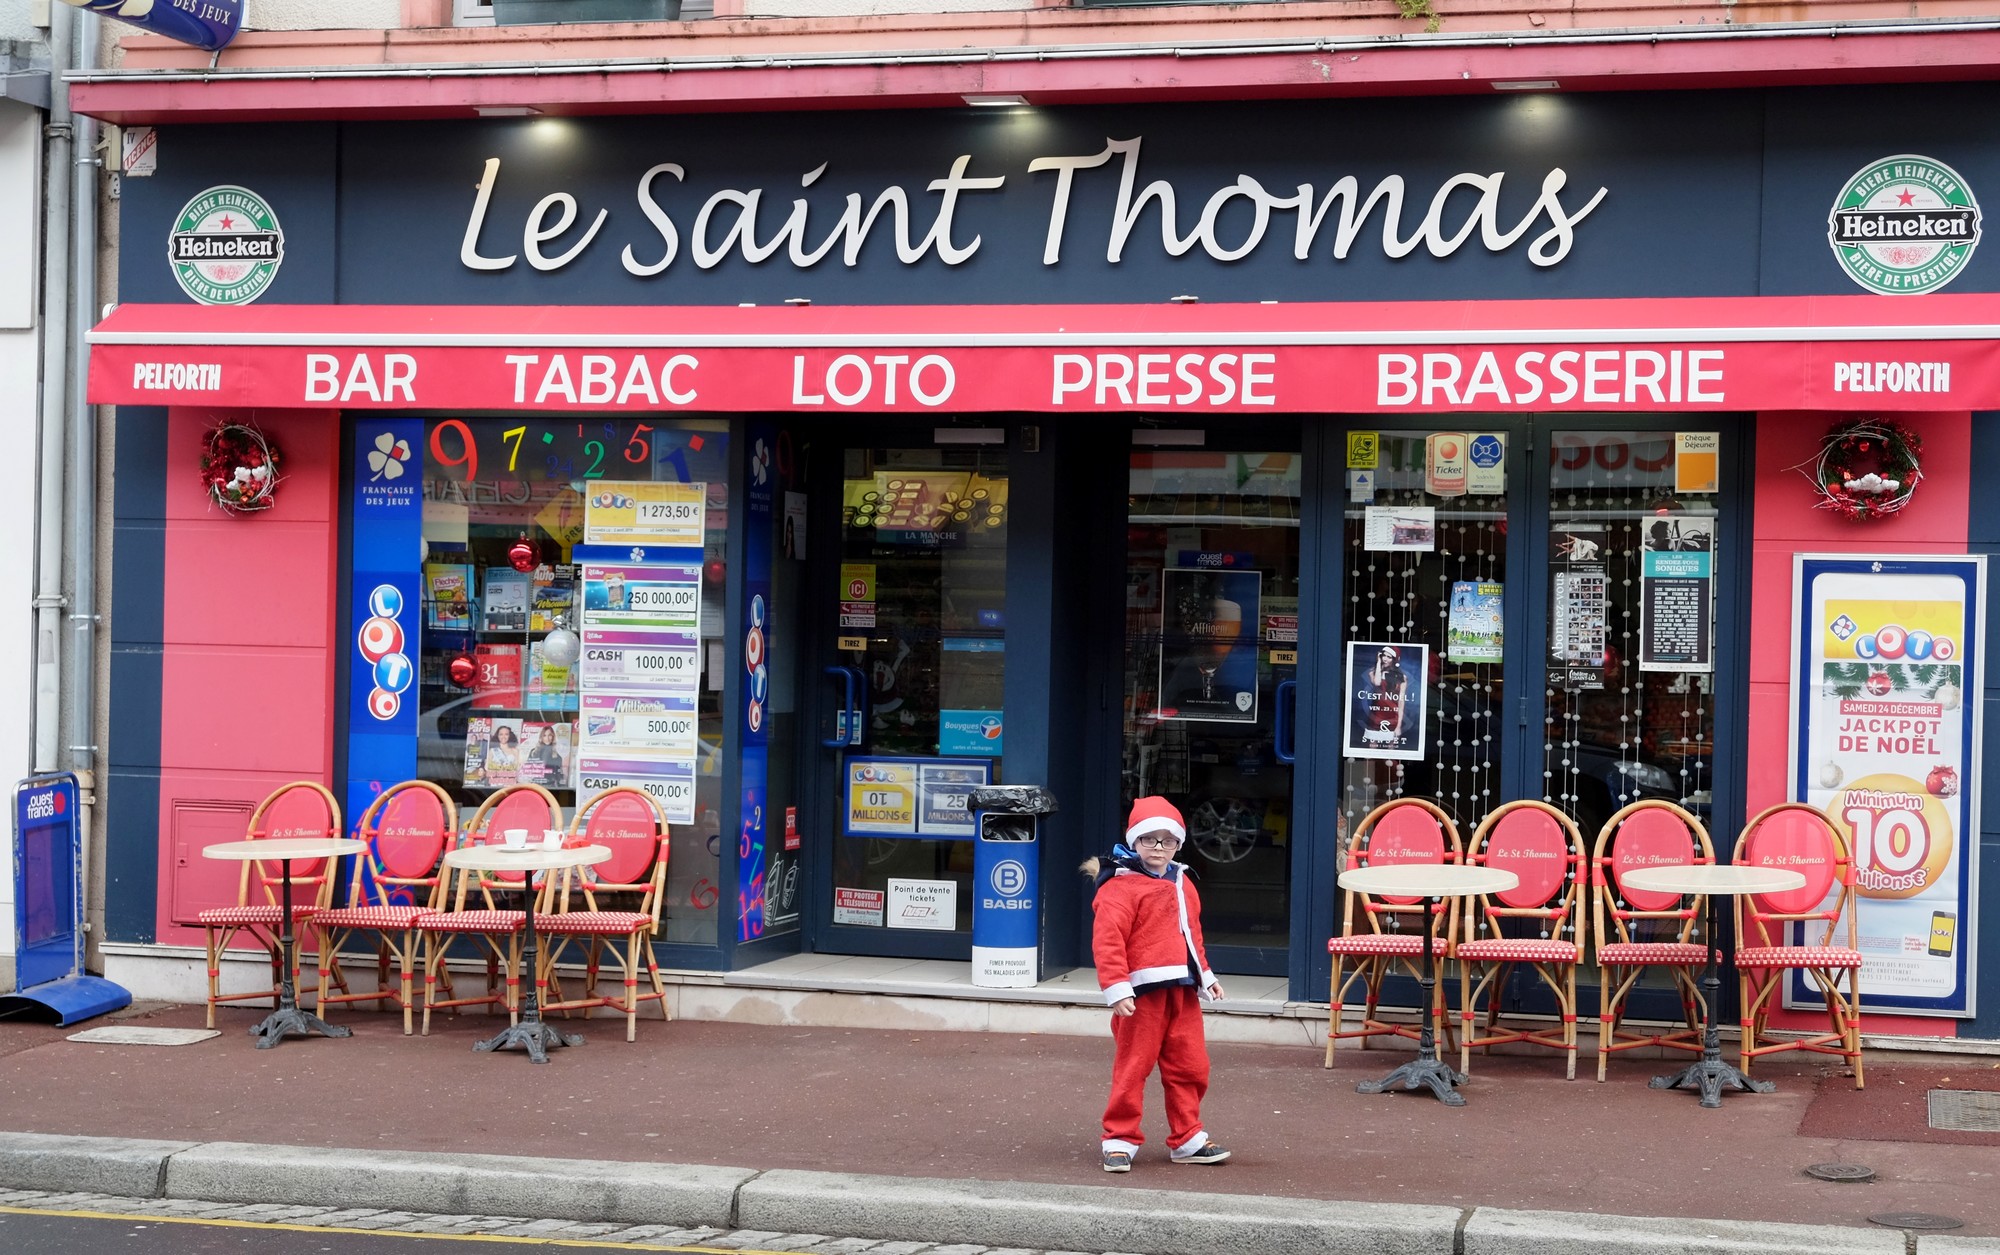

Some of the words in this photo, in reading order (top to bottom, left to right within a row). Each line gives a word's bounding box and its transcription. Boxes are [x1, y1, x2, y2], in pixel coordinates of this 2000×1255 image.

[199, 4, 231, 25] JEUX
[123, 131, 157, 170] LICENCE
[1855, 168, 1892, 198] BIERE
[1894, 165, 1957, 195] HEINEKEN
[218, 194, 265, 220] HEINEKEN
[460, 157, 608, 272] Le
[621, 154, 1005, 277] Saint
[1027, 135, 1609, 268] Thomas
[1842, 215, 1968, 237] Heineken
[178, 236, 274, 257] Heineken
[1849, 251, 1882, 282] BIERE
[1883, 273, 1901, 288] DE
[1904, 251, 1960, 287] PRESTIGE
[209, 287, 223, 300] DE
[225, 268, 268, 300] PRESTIGE
[133, 363, 221, 391] PELFORTH
[304, 353, 418, 403] BAR
[505, 354, 699, 405] TABAC
[792, 354, 956, 406] LOTO
[1052, 353, 1276, 406] PRESSE
[1376, 350, 1726, 406] BRASSERIE
[1833, 361, 1950, 393] PELFORTH
[624, 424, 654, 463] 5
[1685, 434, 1711, 442] Chèque
[503, 426, 527, 472] 7
[1685, 441, 1715, 449] Déjeuner
[583, 440, 606, 478] 2
[1435, 466, 1462, 474] Ticket
[362, 486, 414, 496] FRANÇAISE
[366, 498, 384, 506] DES
[387, 498, 411, 507] JEUX
[642, 505, 648, 517] 1
[652, 505, 690, 521] 273,50
[692, 506, 699, 516] €
[905, 532, 917, 540] LA
[920, 532, 957, 540] MANCHE
[1197, 558, 1223, 566] france
[1200, 553, 1222, 561] ouest
[851, 584, 865, 595] ICI
[628, 592, 648, 604] 250
[1551, 572, 1565, 661] Abonnez-vous
[844, 640, 860, 648] TIREZ
[1854, 624, 1956, 661] LOTO
[636, 655, 683, 671] 1000,00
[688, 657, 695, 665] €
[1277, 653, 1293, 661] TIREZ
[1843, 703, 1877, 714] SAMEDI
[1878, 704, 1889, 714] 24
[1890, 702, 1939, 715] DÉCEMBRE
[944, 722, 979, 731] Bouygues
[1839, 718, 1942, 735] JACKPOT
[1838, 735, 1869, 752] DE
[1877, 734, 1941, 755] NOËL
[855, 766, 896, 783] LOTO
[643, 784, 681, 799] 500,00
[684, 787, 690, 795] €
[30, 790, 54, 807] ouest
[946, 795, 966, 808] 25
[1844, 788, 1925, 811] Minimum
[27, 803, 54, 820] france
[852, 810, 900, 821] MILLIONS
[901, 811, 910, 820] €
[928, 811, 966, 821] MILLIONS
[272, 829, 282, 838] Le
[283, 829, 293, 837] St
[293, 828, 321, 837] Thomas
[384, 827, 394, 836] Le
[397, 827, 406, 836] St
[406, 828, 435, 836] Thomas
[493, 832, 503, 840] Le
[593, 830, 604, 838] Le
[606, 830, 615, 838] St
[615, 830, 647, 839] Thomas
[1843, 807, 1930, 875] 10
[1374, 849, 1386, 857] Le
[1387, 849, 1397, 858] St
[1399, 848, 1433, 858] Thomas
[1497, 849, 1508, 858] Le
[1510, 849, 1521, 858] St
[1522, 849, 1557, 859] Thomas
[1622, 855, 1634, 864] Le
[1635, 855, 1646, 864] St
[1647, 855, 1684, 864] Thomas
[1762, 855, 1774, 865] Le
[1775, 855, 1787, 864] St
[1788, 855, 1825, 865] Thomas
[1001, 868, 1019, 888] B
[842, 891, 853, 899] SITE
[895, 885, 914, 893] Point
[929, 886, 951, 894] Vente
[909, 895, 936, 903] tickets
[983, 899, 1032, 910] BASIC
